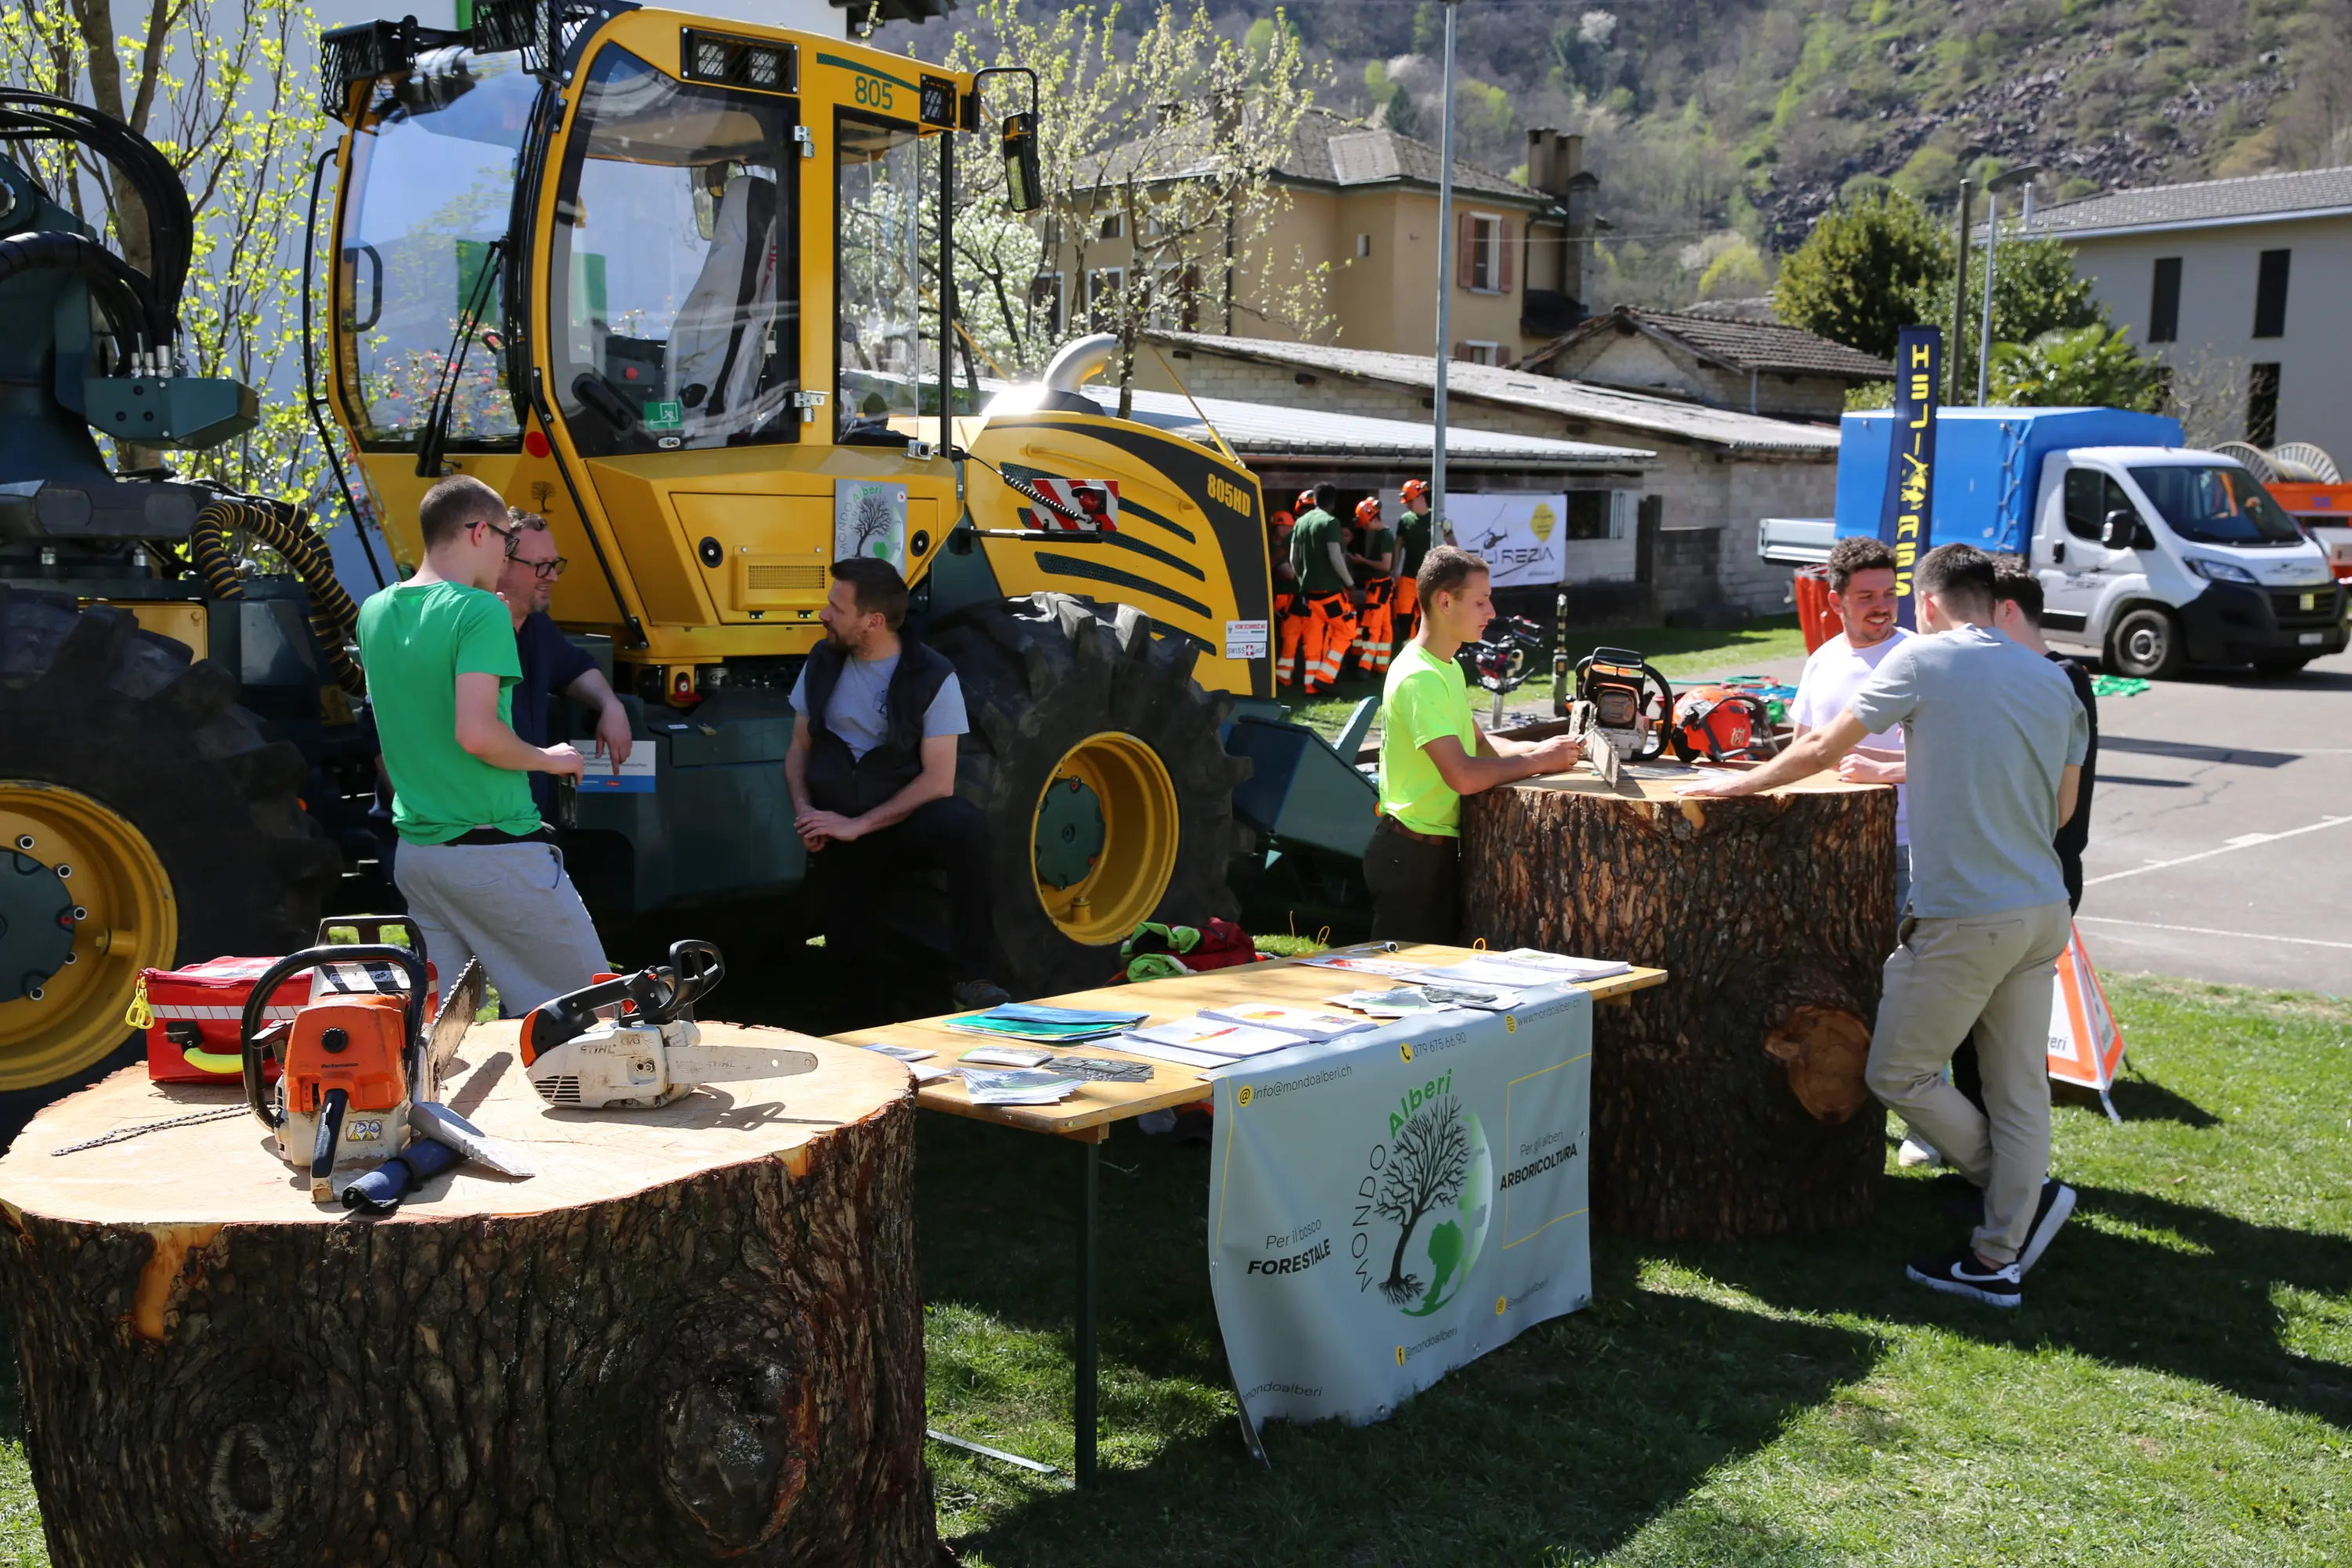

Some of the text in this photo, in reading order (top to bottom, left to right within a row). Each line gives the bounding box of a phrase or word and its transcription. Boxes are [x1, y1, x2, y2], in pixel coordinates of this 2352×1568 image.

[855, 75, 893, 110] 805
[853, 485, 883, 501] Alberi
[1207, 473, 1251, 517] 805HD
[579, 1044, 615, 1054] STIHL
[1413, 1032, 1467, 1057] 079 675 66 90
[1253, 1063, 1352, 1099] info@mondoalberi.ch
[1389, 1068, 1453, 1140] Alberi
[1519, 1145, 1534, 1157] Per
[1542, 1130, 1563, 1147] alberi
[1499, 1143, 1578, 1192] ARBORICOLTURA
[1265, 1218, 1322, 1250] Per il bosco
[1352, 1145, 1386, 1293] MONDO
[1247, 1239, 1331, 1275] FORESTALE
[1405, 1324, 1457, 1360] @mondoalberi
